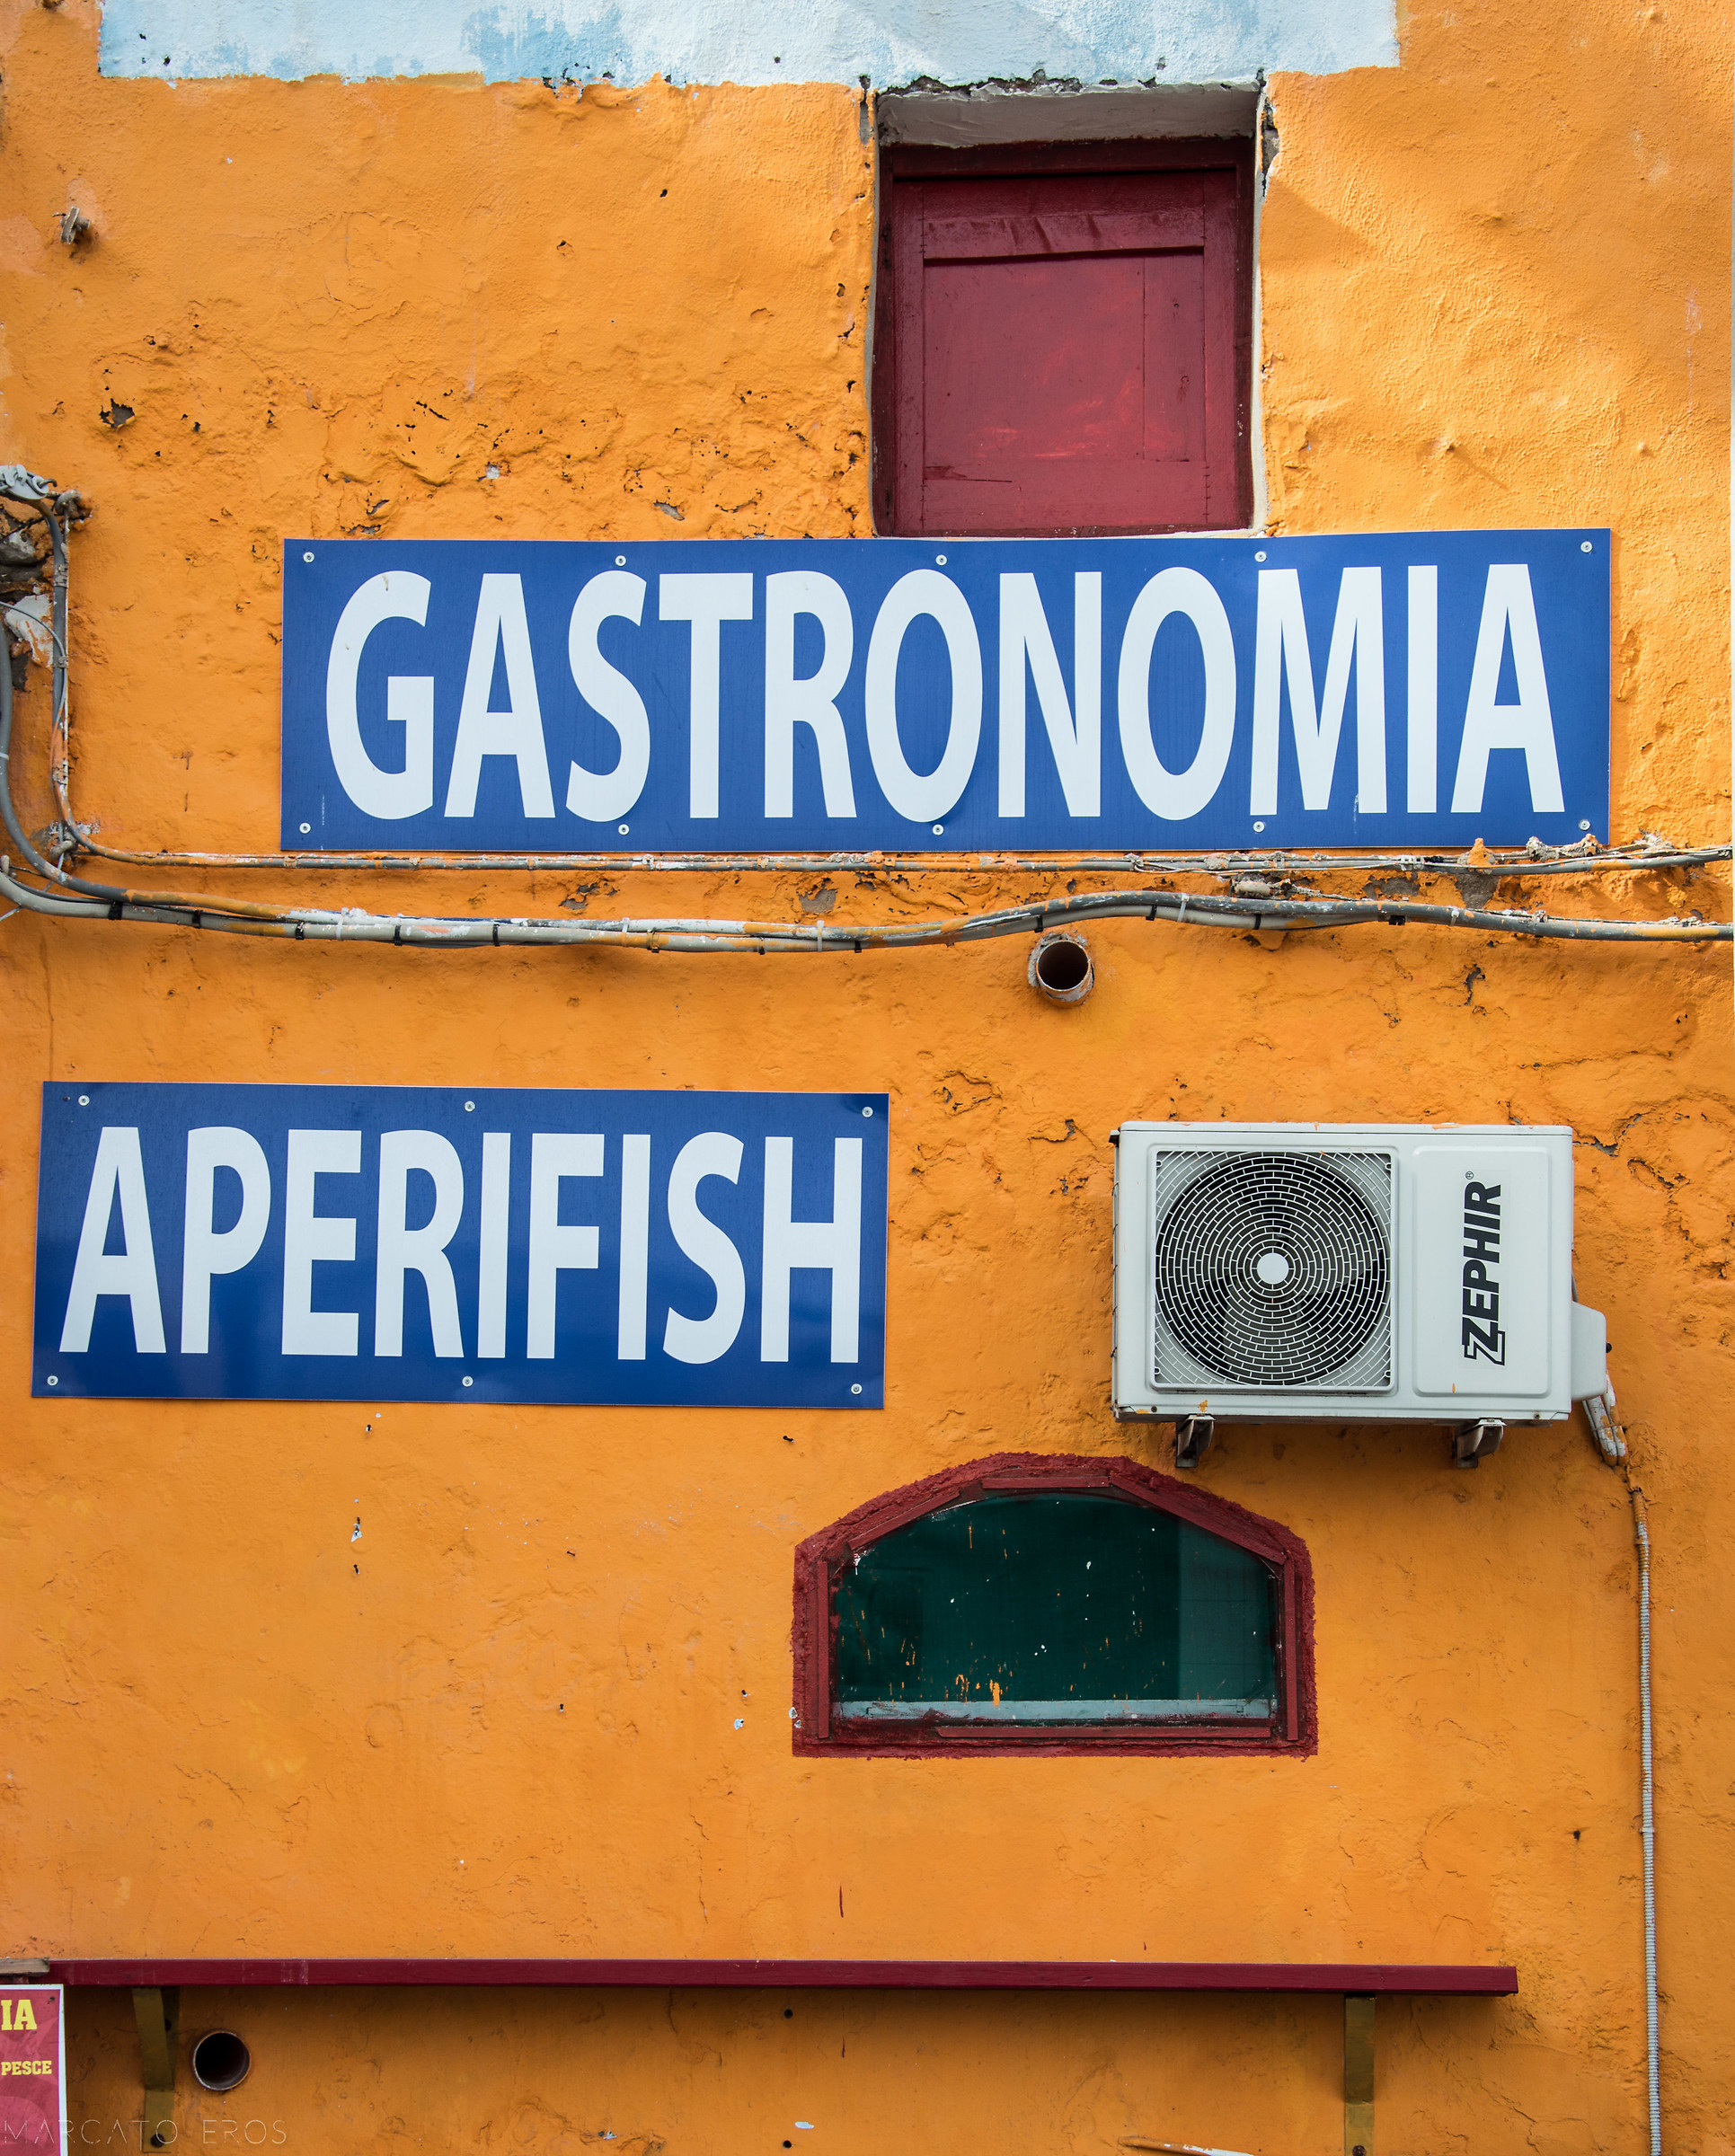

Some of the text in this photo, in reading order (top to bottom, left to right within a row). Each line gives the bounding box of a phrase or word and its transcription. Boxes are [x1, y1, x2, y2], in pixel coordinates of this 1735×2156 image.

[326, 564, 1564, 822] GASTRONOMIA
[59, 1127, 863, 1365] APERIFISH
[1, 2060, 52, 2076] PESCE
